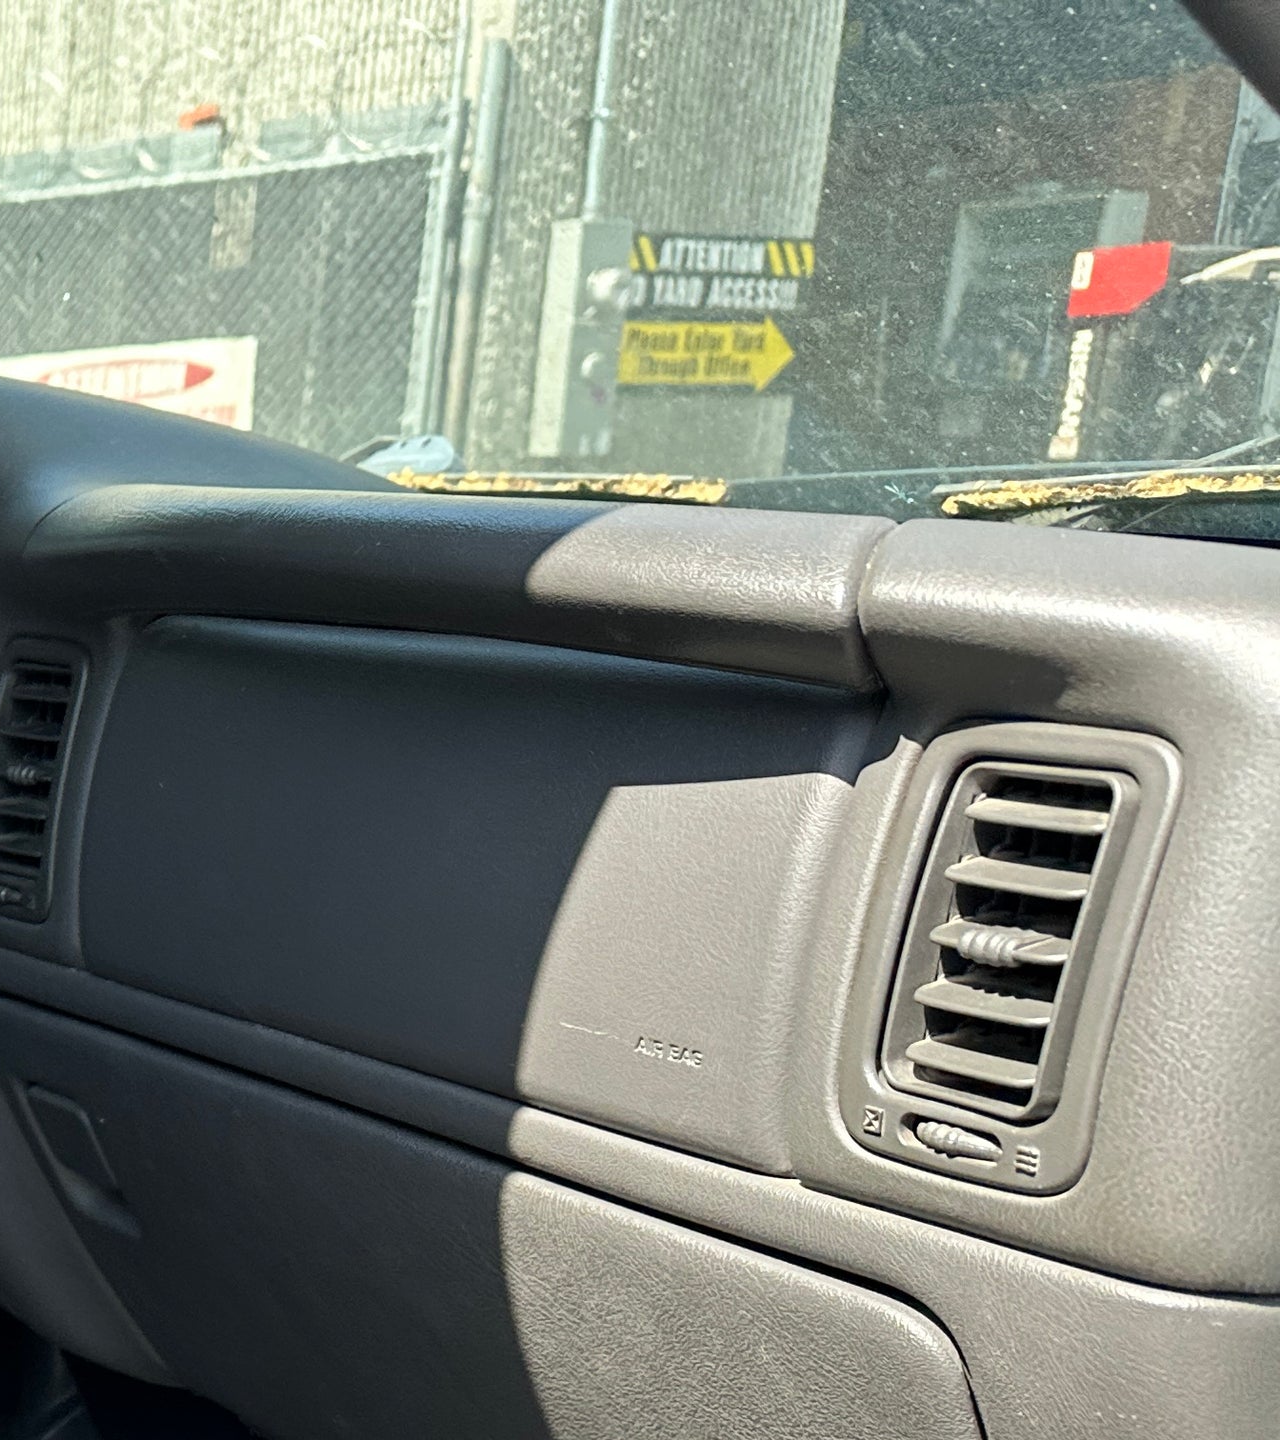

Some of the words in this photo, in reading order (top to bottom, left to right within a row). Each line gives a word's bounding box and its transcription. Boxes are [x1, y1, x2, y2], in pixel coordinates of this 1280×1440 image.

[659, 237, 766, 273] ATTENTION
[653, 275, 705, 308] YARD
[634, 1036, 663, 1059] AIR
[666, 1043, 704, 1068] BAG
